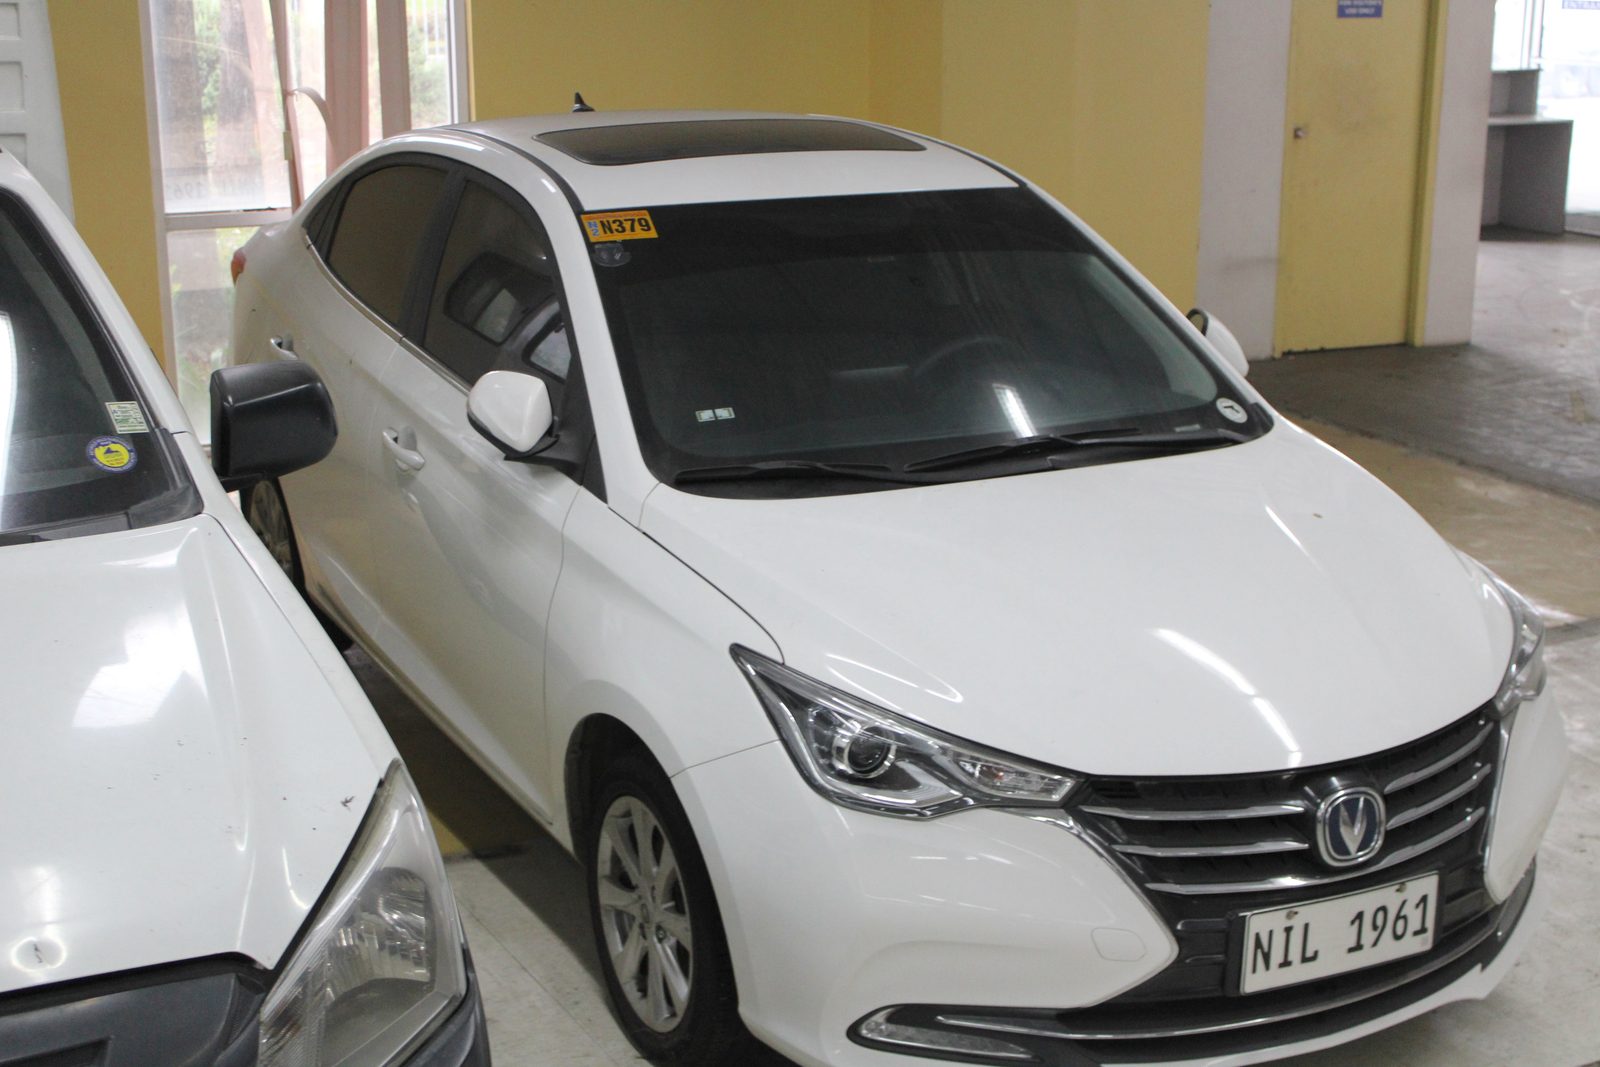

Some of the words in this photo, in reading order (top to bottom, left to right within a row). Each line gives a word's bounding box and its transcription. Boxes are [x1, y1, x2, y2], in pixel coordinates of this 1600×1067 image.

[599, 217, 652, 235] N379
[1251, 922, 1319, 975] NIL
[1346, 893, 1429, 954] 1961
